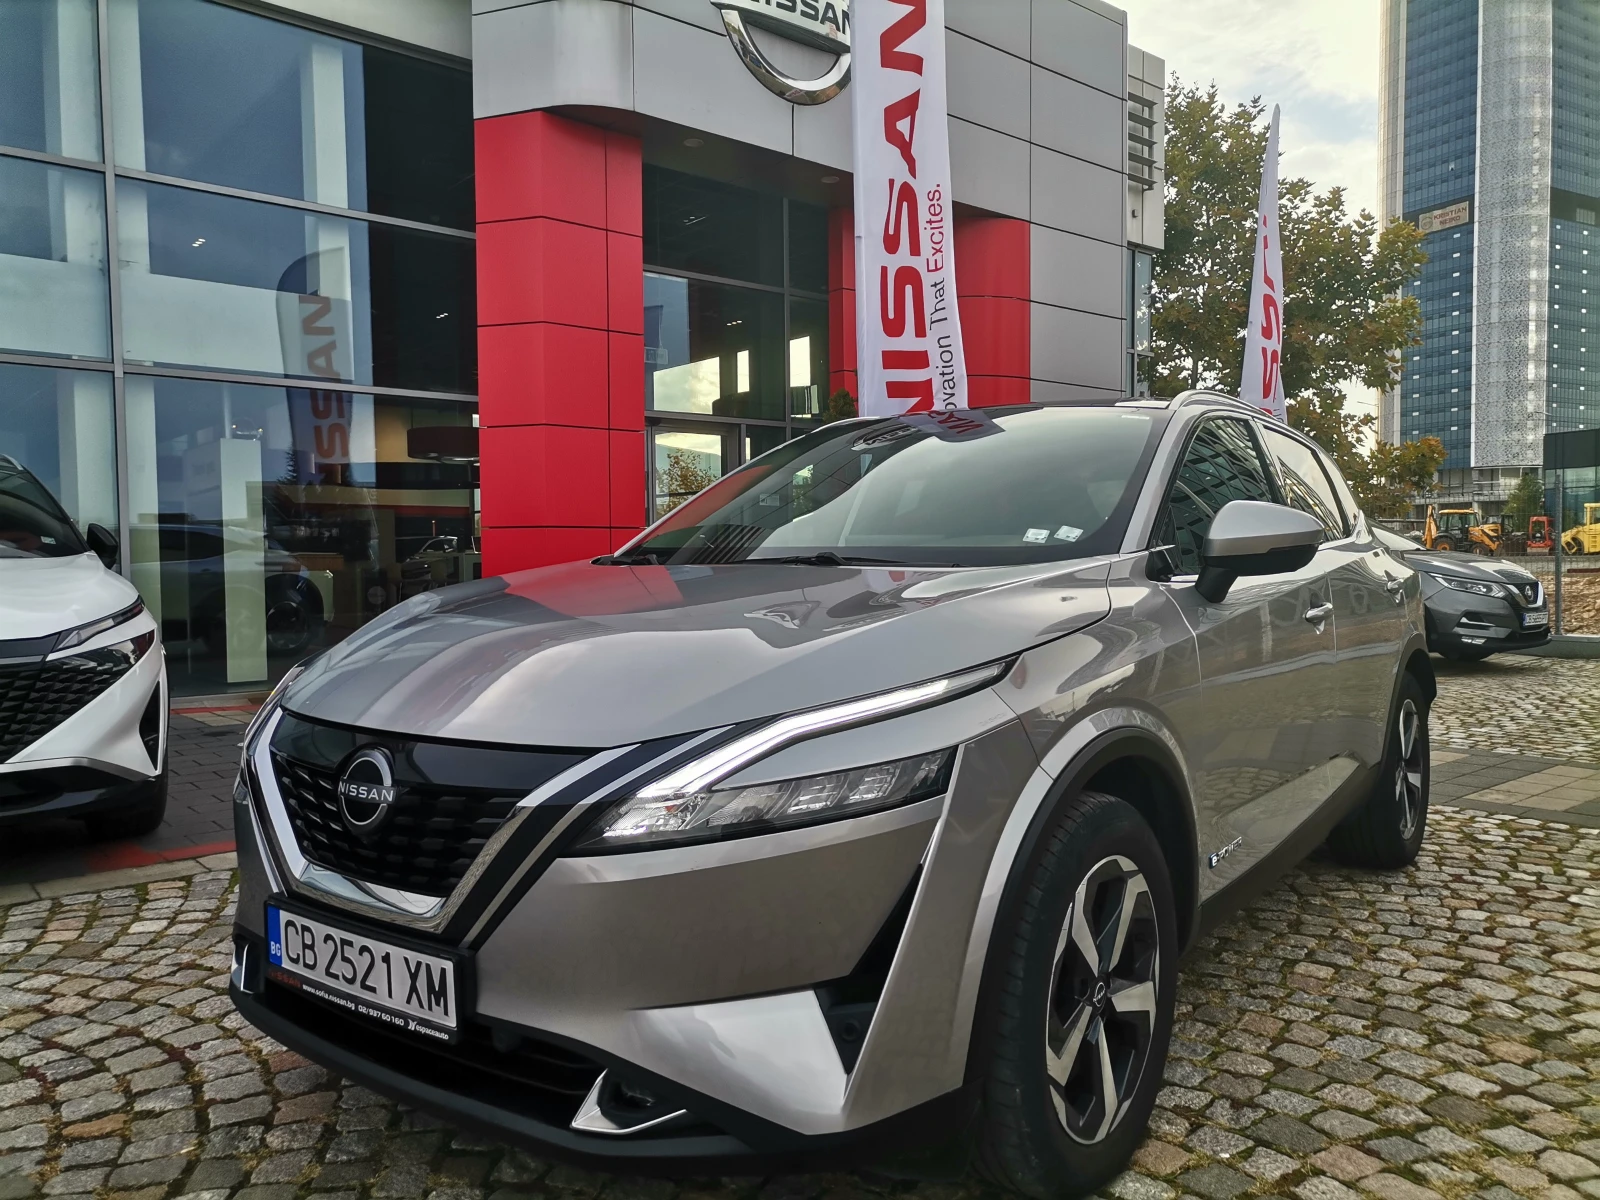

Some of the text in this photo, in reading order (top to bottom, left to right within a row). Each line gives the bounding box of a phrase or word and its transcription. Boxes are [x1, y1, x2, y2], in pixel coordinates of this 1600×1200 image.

[924, 183, 945, 273] Excites.
[929, 277, 948, 331] That
[339, 780, 394, 802] NISSAN
[270, 940, 282, 957] BG
[284, 919, 450, 1017] CB 2521 XM
[302, 983, 355, 1011] www.sofia.nissan.bg
